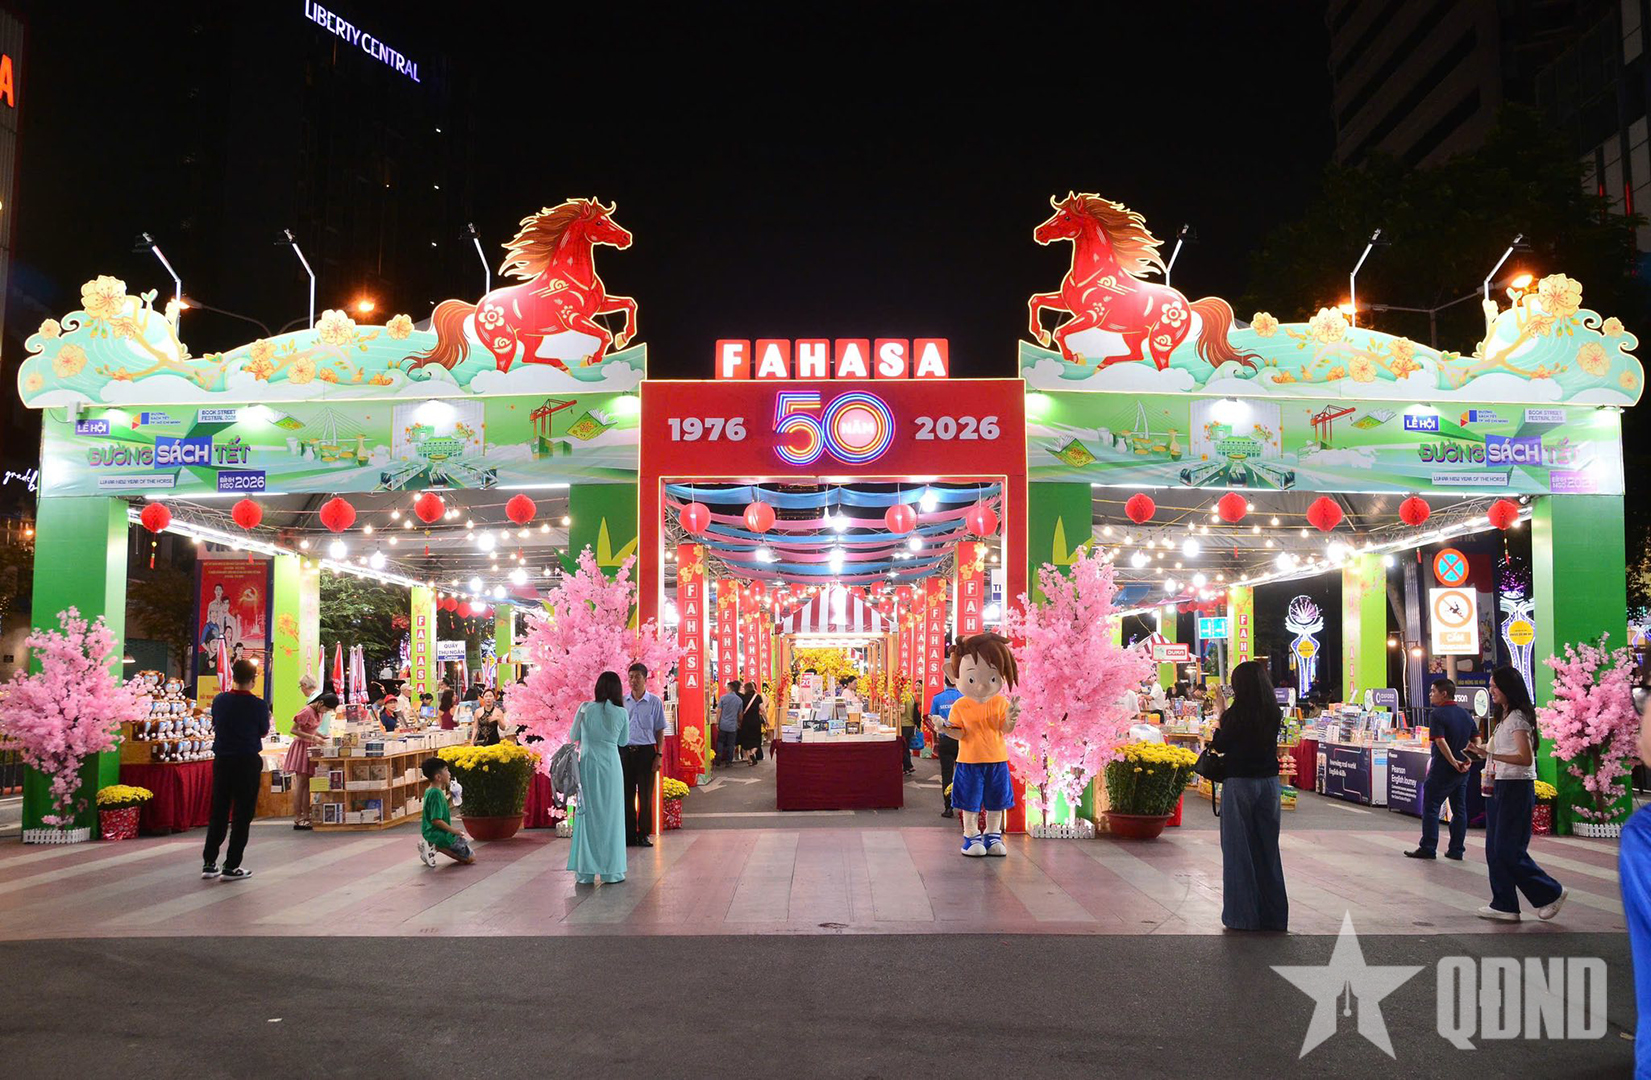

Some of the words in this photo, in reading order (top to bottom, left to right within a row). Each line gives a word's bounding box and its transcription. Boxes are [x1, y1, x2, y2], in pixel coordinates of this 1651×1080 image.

[305, 0, 361, 45] LIBERTY
[361, 33, 420, 83] CENTRAL
[722, 342, 947, 378] FAHASA
[77, 421, 89, 433] LỄ
[91, 421, 107, 434] HỘI
[668, 417, 747, 442] 1976
[772, 390, 896, 466] 50
[841, 419, 874, 435] NĂM
[914, 416, 1001, 441] 2026
[1406, 415, 1418, 428] LỄ
[1419, 416, 1436, 430] HỘI
[88, 442, 153, 467] ĐƯỜNG
[156, 439, 209, 464] SÁCH
[214, 435, 251, 464] TẾT
[1418, 439, 1486, 463] ĐƯỜNG
[1488, 438, 1539, 463] SÁCH
[1543, 437, 1579, 464] TẾT
[235, 476, 265, 489] 2026
[966, 583, 976, 630] FAH
[686, 584, 697, 686] FAHASA
[930, 609, 940, 686] FAHASA
[417, 616, 425, 693] FAHASA
[748, 624, 756, 683] FAHAS
[1391, 764, 1406, 774] Pearson
